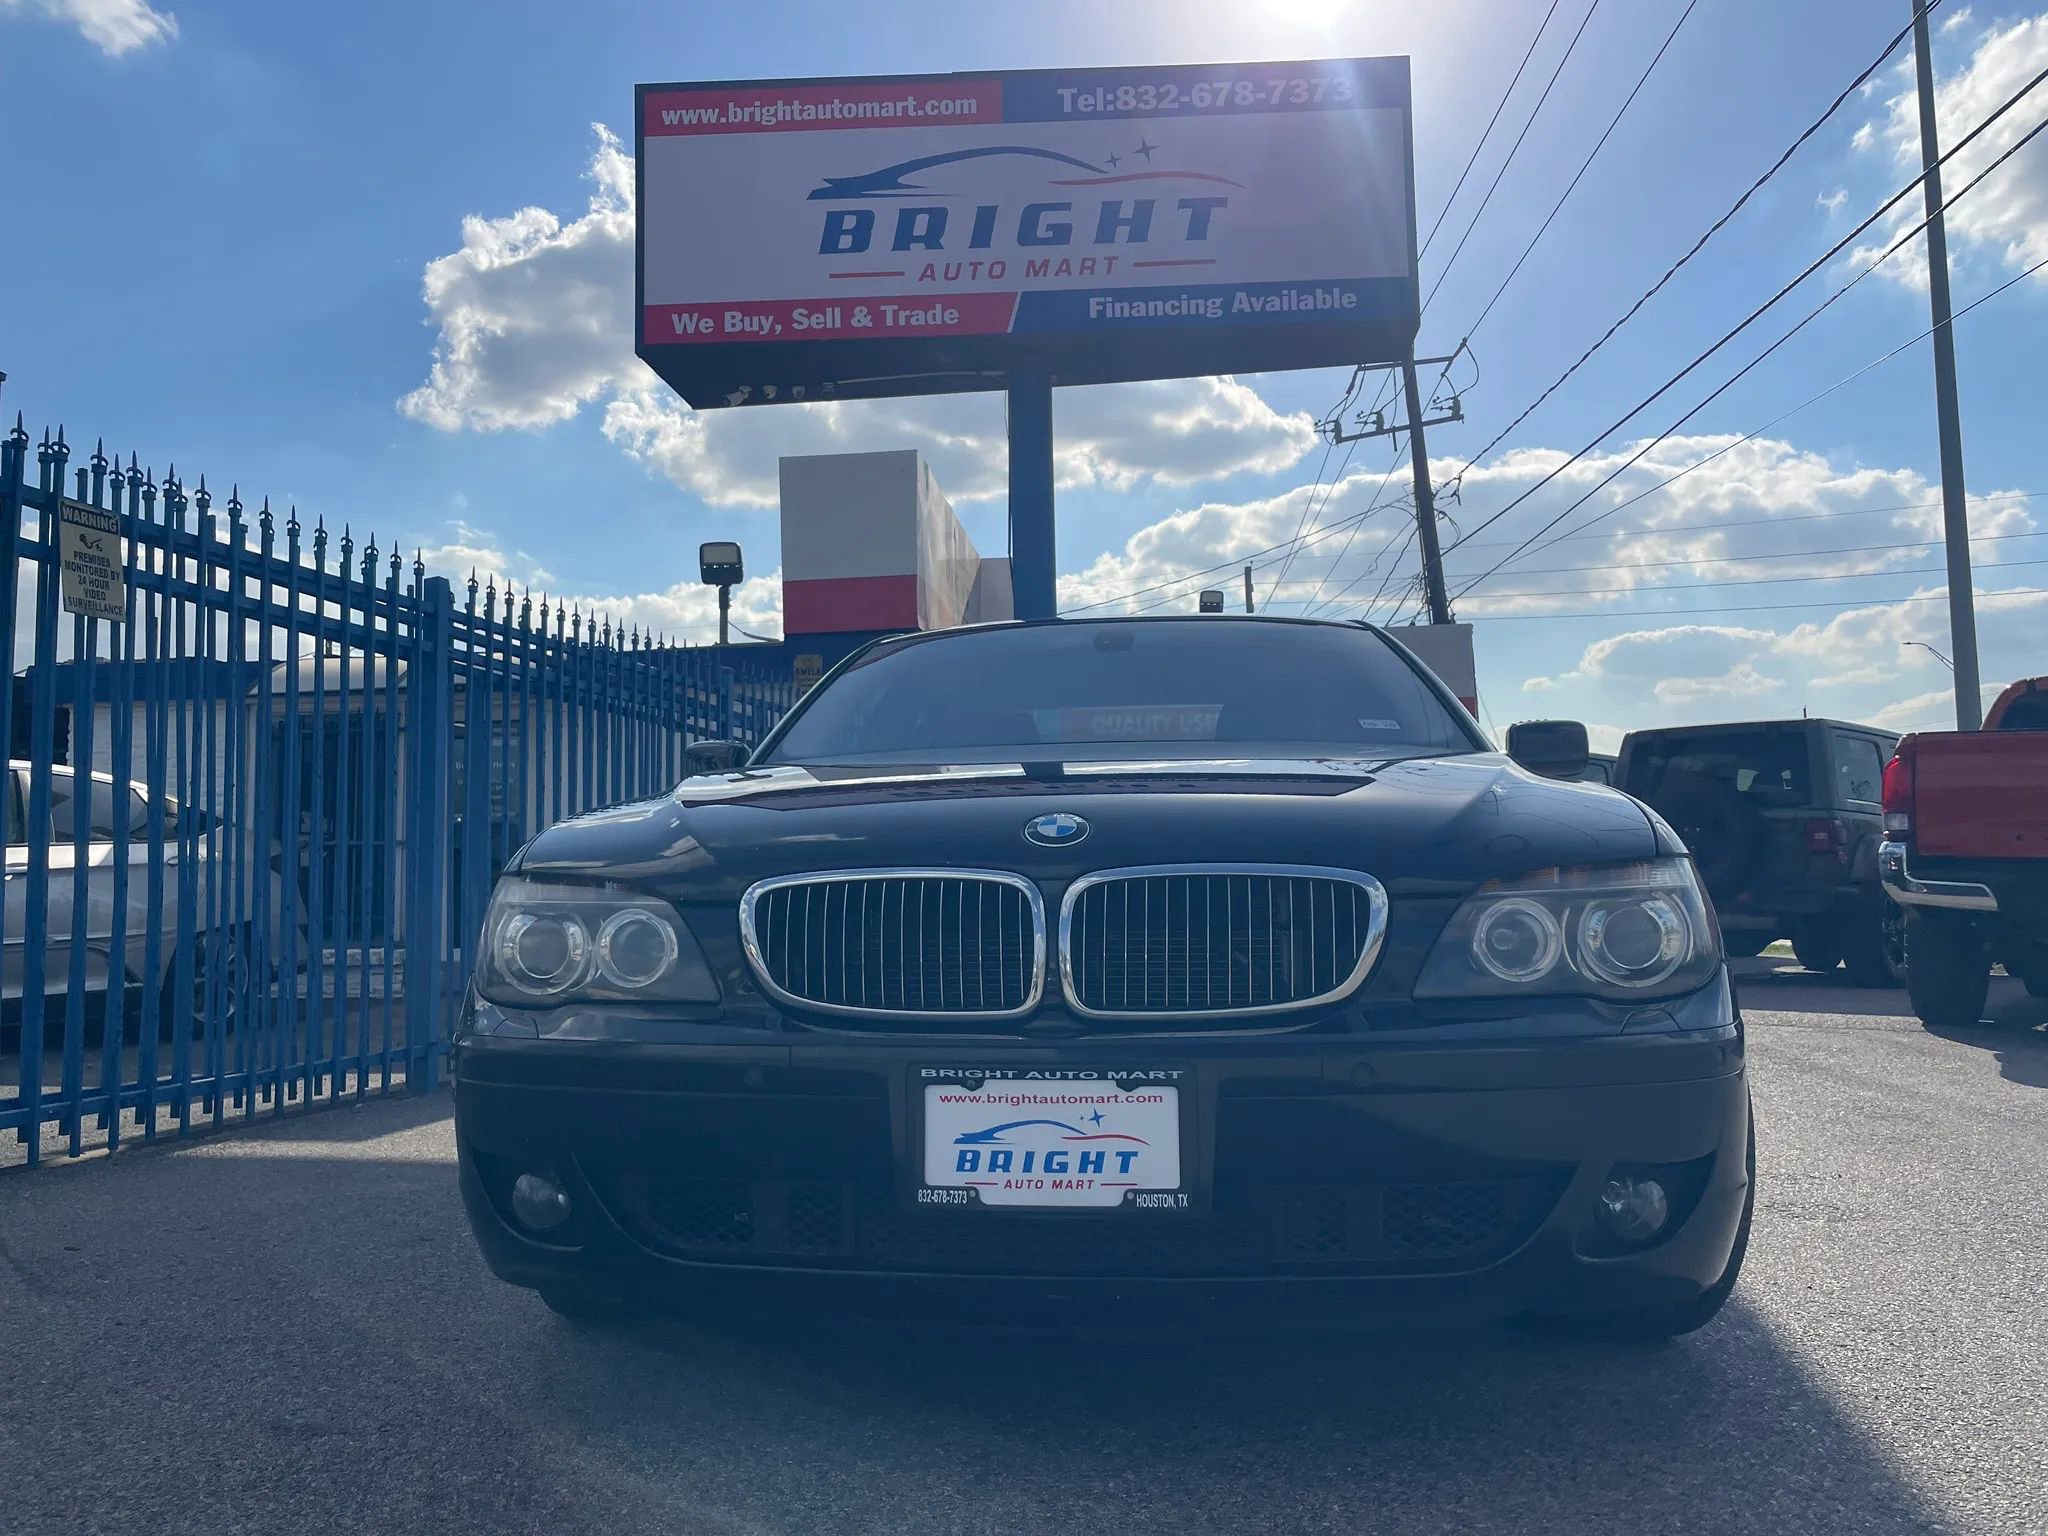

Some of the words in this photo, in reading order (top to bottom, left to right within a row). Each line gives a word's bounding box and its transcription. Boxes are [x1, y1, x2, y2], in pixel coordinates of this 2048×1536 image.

[1057, 77, 1352, 112] Tel:832-678-7373
[661, 95, 977, 126] www.brightautomart.com
[818, 197, 1229, 254] BRIGHT
[918, 260, 1008, 282] AUTO
[1025, 256, 1121, 278] MART
[1088, 294, 1224, 319] Financing
[1231, 288, 1357, 313] Available
[671, 312, 715, 334] We
[723, 310, 783, 336] Buy,
[791, 307, 843, 329] Sell
[851, 306, 873, 328] &
[879, 304, 959, 326] Trade
[62, 507, 118, 532] WARNING
[73, 550, 110, 568] PREMISES
[64, 559, 109, 579] MONITORED
[110, 570, 120, 581] BY
[78, 574, 87, 585] 24
[88, 577, 110, 591] HOUR
[83, 586, 106, 601] VIDEO
[67, 595, 123, 616] SURVEILLANCE
[920, 1068, 1018, 1078] BRIGHT
[1024, 1070, 1099, 1080] AUTO
[1107, 1070, 1184, 1080] MART
[939, 1092, 1164, 1106] www.brightautomart.com
[955, 1149, 1139, 1174] BRIGHT
[1003, 1179, 1044, 1190] AUTO
[1051, 1179, 1095, 1190] MART
[917, 1189, 968, 1204] 832-678-7373
[1136, 1194, 1176, 1209] HOUSTON,
[1178, 1194, 1188, 1208] TX
